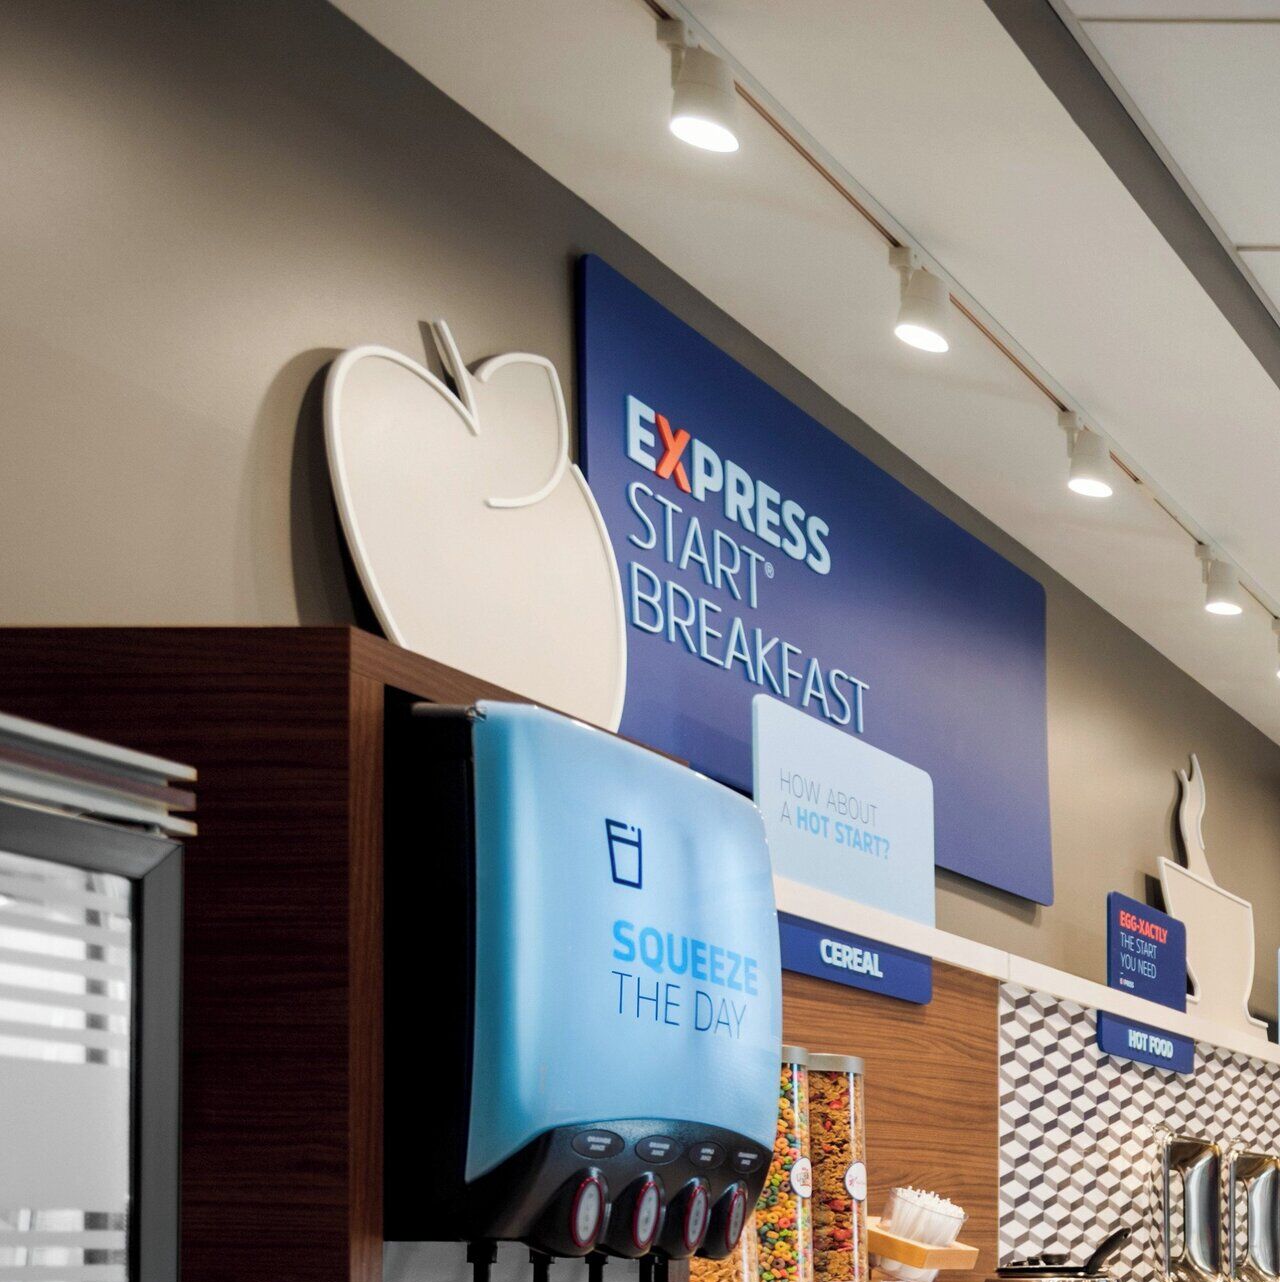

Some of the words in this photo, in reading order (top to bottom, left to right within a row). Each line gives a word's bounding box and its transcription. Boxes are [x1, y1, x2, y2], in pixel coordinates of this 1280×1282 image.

[627, 394, 831, 575] EXPRESS
[631, 561, 870, 733] BREAKFAST
[780, 767, 821, 804] HOW
[826, 788, 879, 827] ABOUT
[781, 801, 792, 826] A
[796, 805, 831, 838] HOT
[834, 821, 890, 860] START?
[1119, 910, 1168, 944] EGG-XACTLY
[1120, 931, 1135, 952] THE
[1136, 937, 1157, 960] START
[612, 919, 759, 996] SQUEEZE
[820, 938, 883, 978] CEREAL
[1120, 953, 1137, 972] YOU
[1138, 960, 1157, 979] NEED
[612, 970, 681, 1026] THE
[694, 990, 747, 1040] DAY
[1128, 1029, 1148, 1052] HOT
[1149, 1035, 1174, 1059] FOOD
